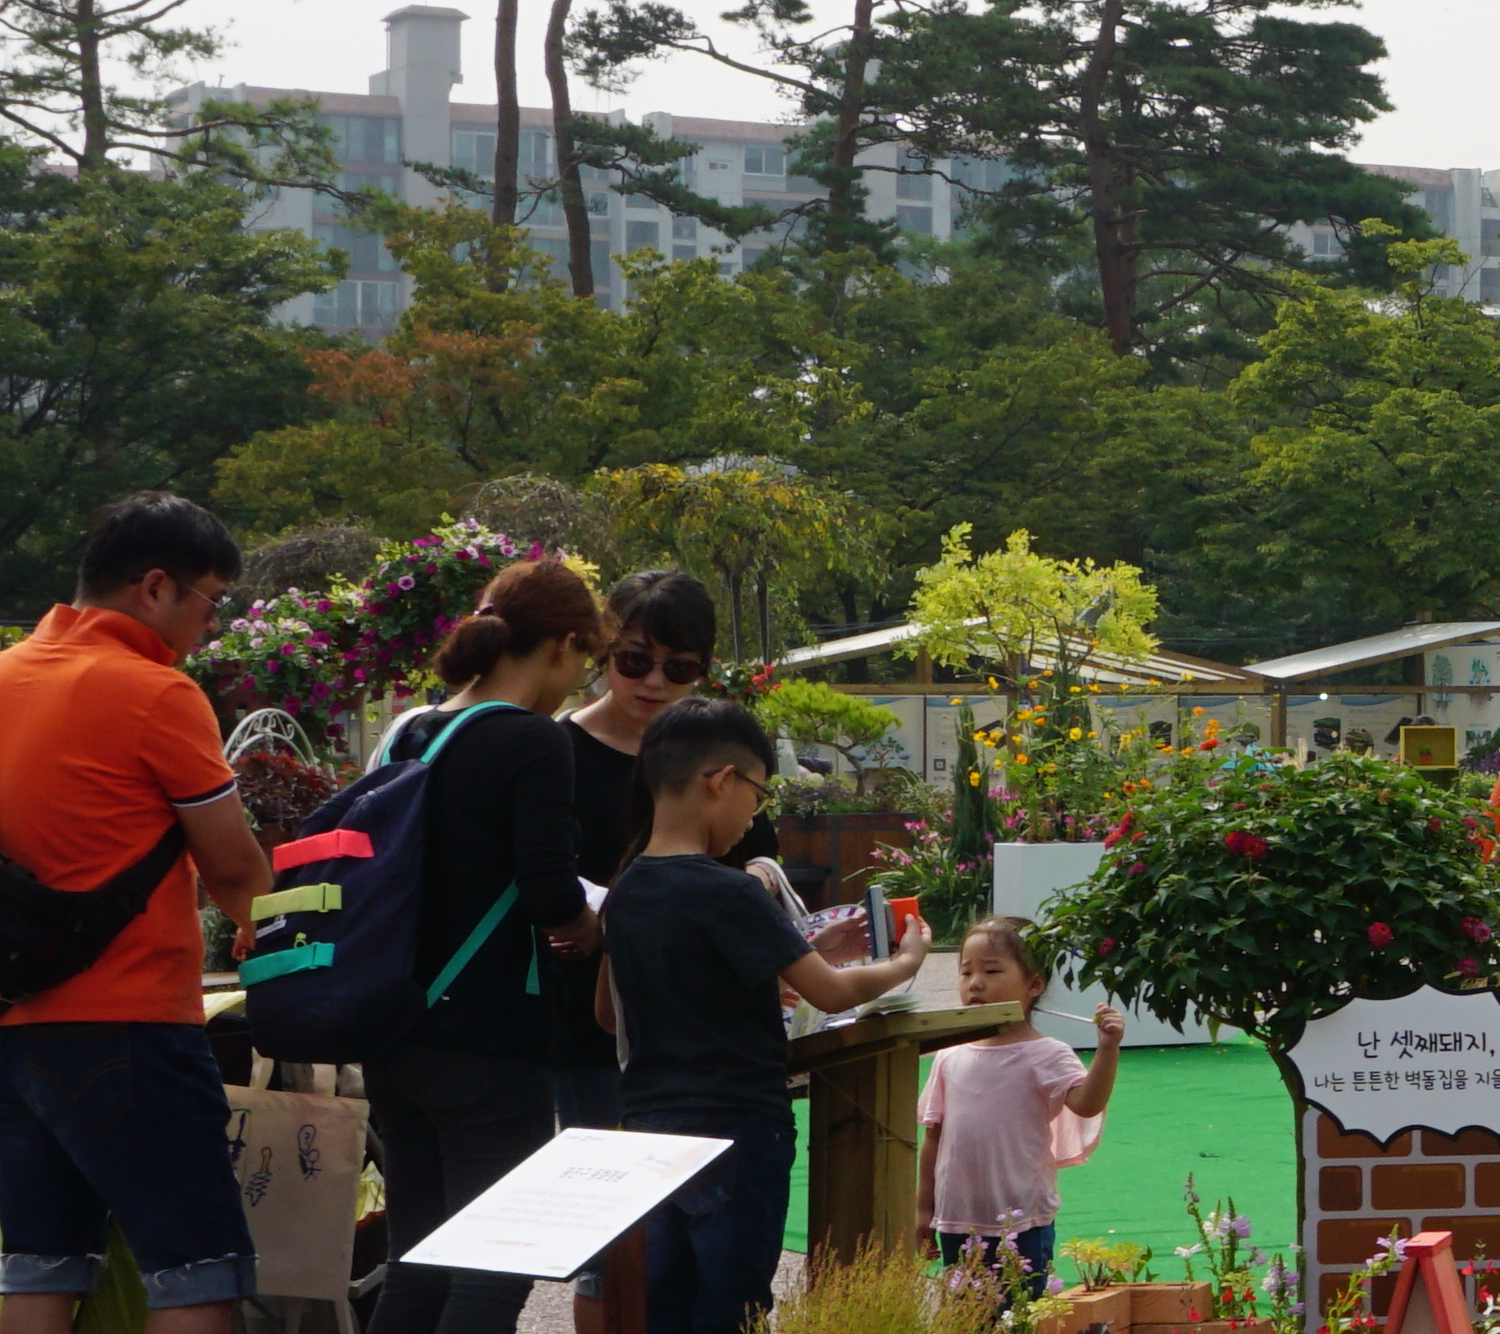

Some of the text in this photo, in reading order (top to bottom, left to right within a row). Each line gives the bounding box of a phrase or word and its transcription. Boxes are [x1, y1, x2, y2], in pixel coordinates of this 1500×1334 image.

[1357, 1029, 1496, 1060] 난 셋째돼지,
[1314, 1070, 1346, 1093] 나는
[1351, 1070, 1401, 1092] 튼튼한
[1405, 1069, 1469, 1091] 벽돌집을
